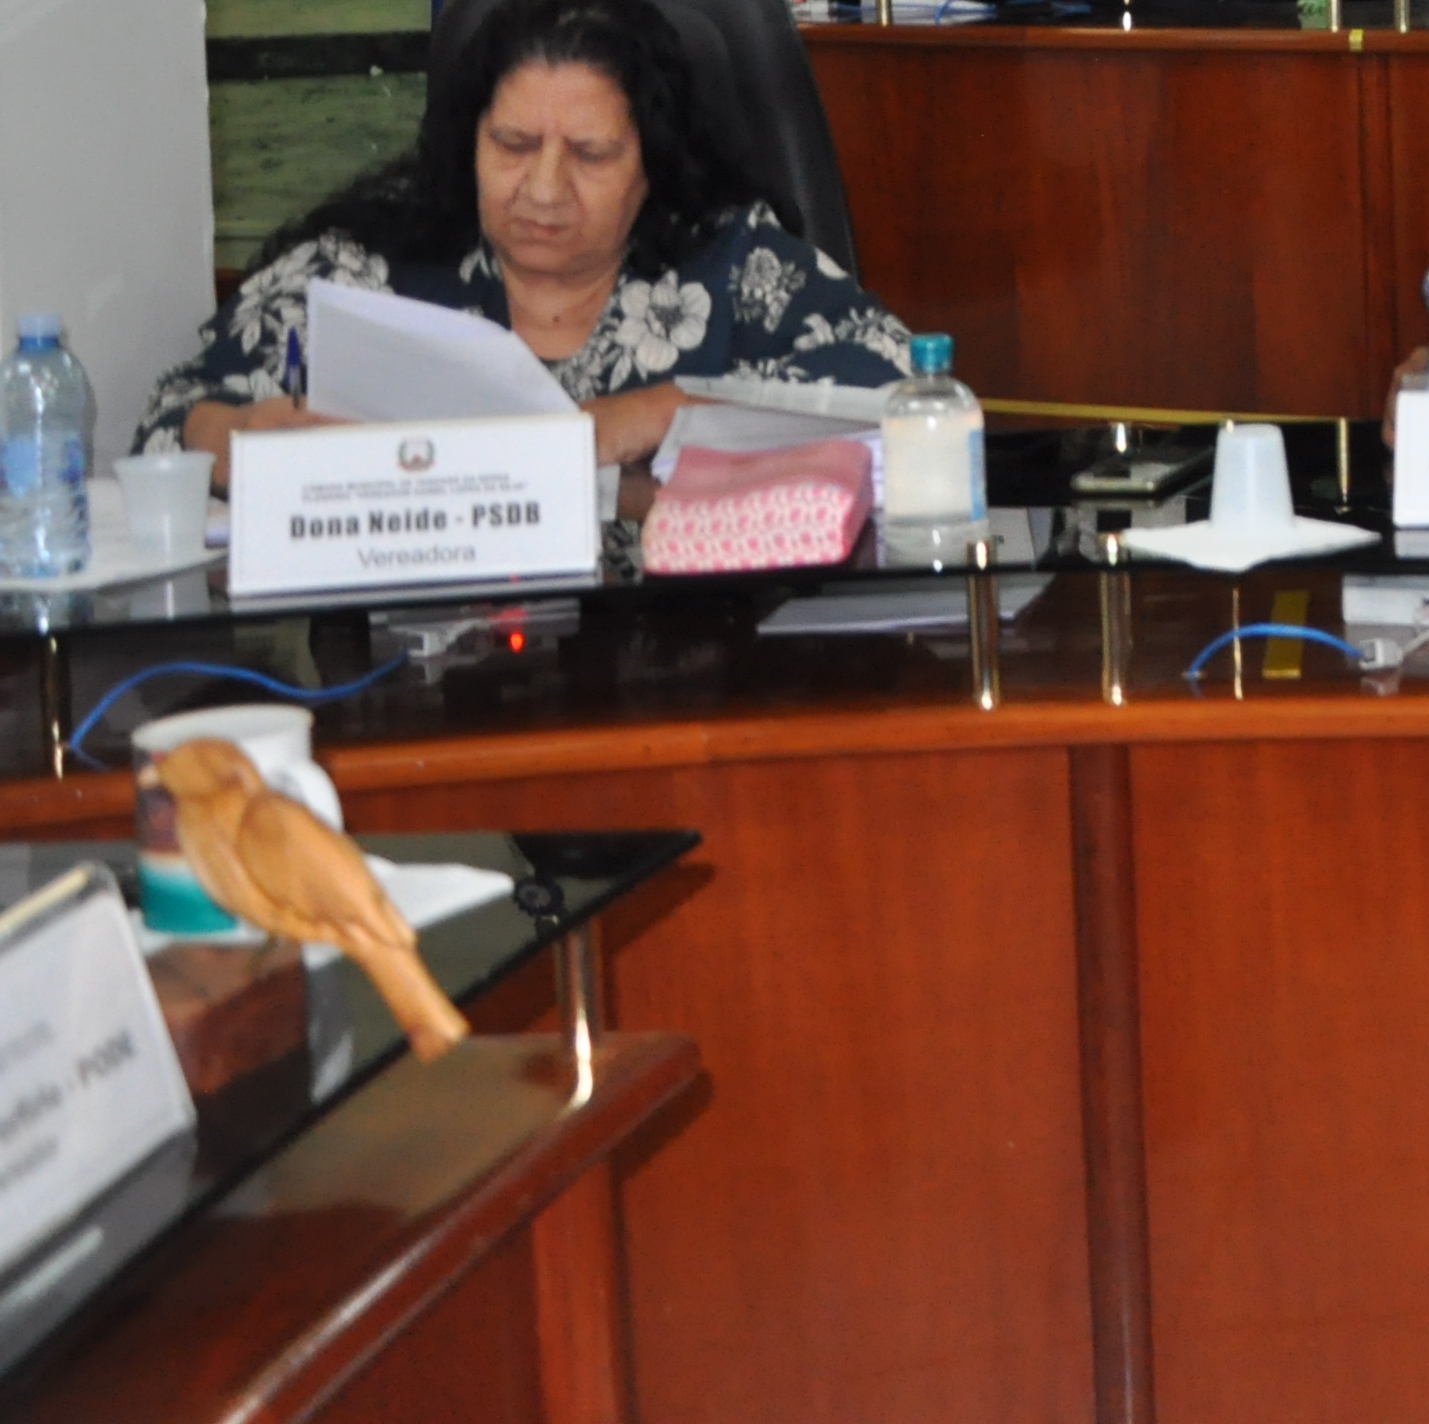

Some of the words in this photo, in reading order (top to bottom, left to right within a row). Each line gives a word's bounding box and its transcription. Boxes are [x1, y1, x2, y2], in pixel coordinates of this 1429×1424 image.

[290, 514, 360, 540] Dona
[368, 507, 447, 534] Neide
[472, 500, 541, 528] PSDB
[358, 544, 476, 569] Vereadora
